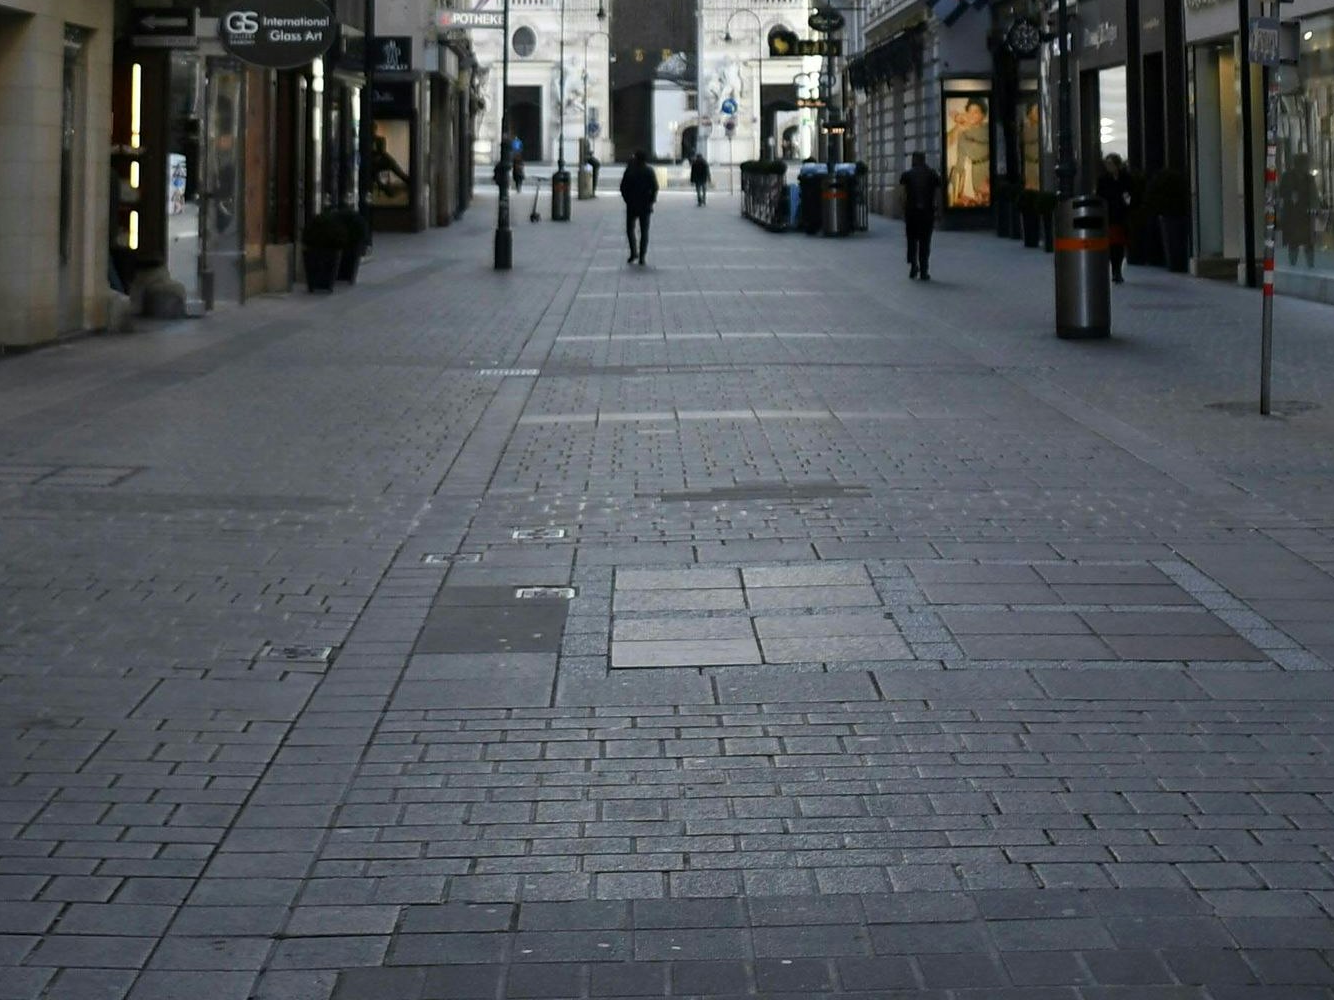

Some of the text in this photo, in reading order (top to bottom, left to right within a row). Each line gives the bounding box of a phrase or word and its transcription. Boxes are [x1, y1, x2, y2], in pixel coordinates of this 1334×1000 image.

[226, 10, 259, 34] GS
[262, 16, 329, 28] International
[269, 28, 302, 42] Glass
[305, 29, 323, 41] Art
